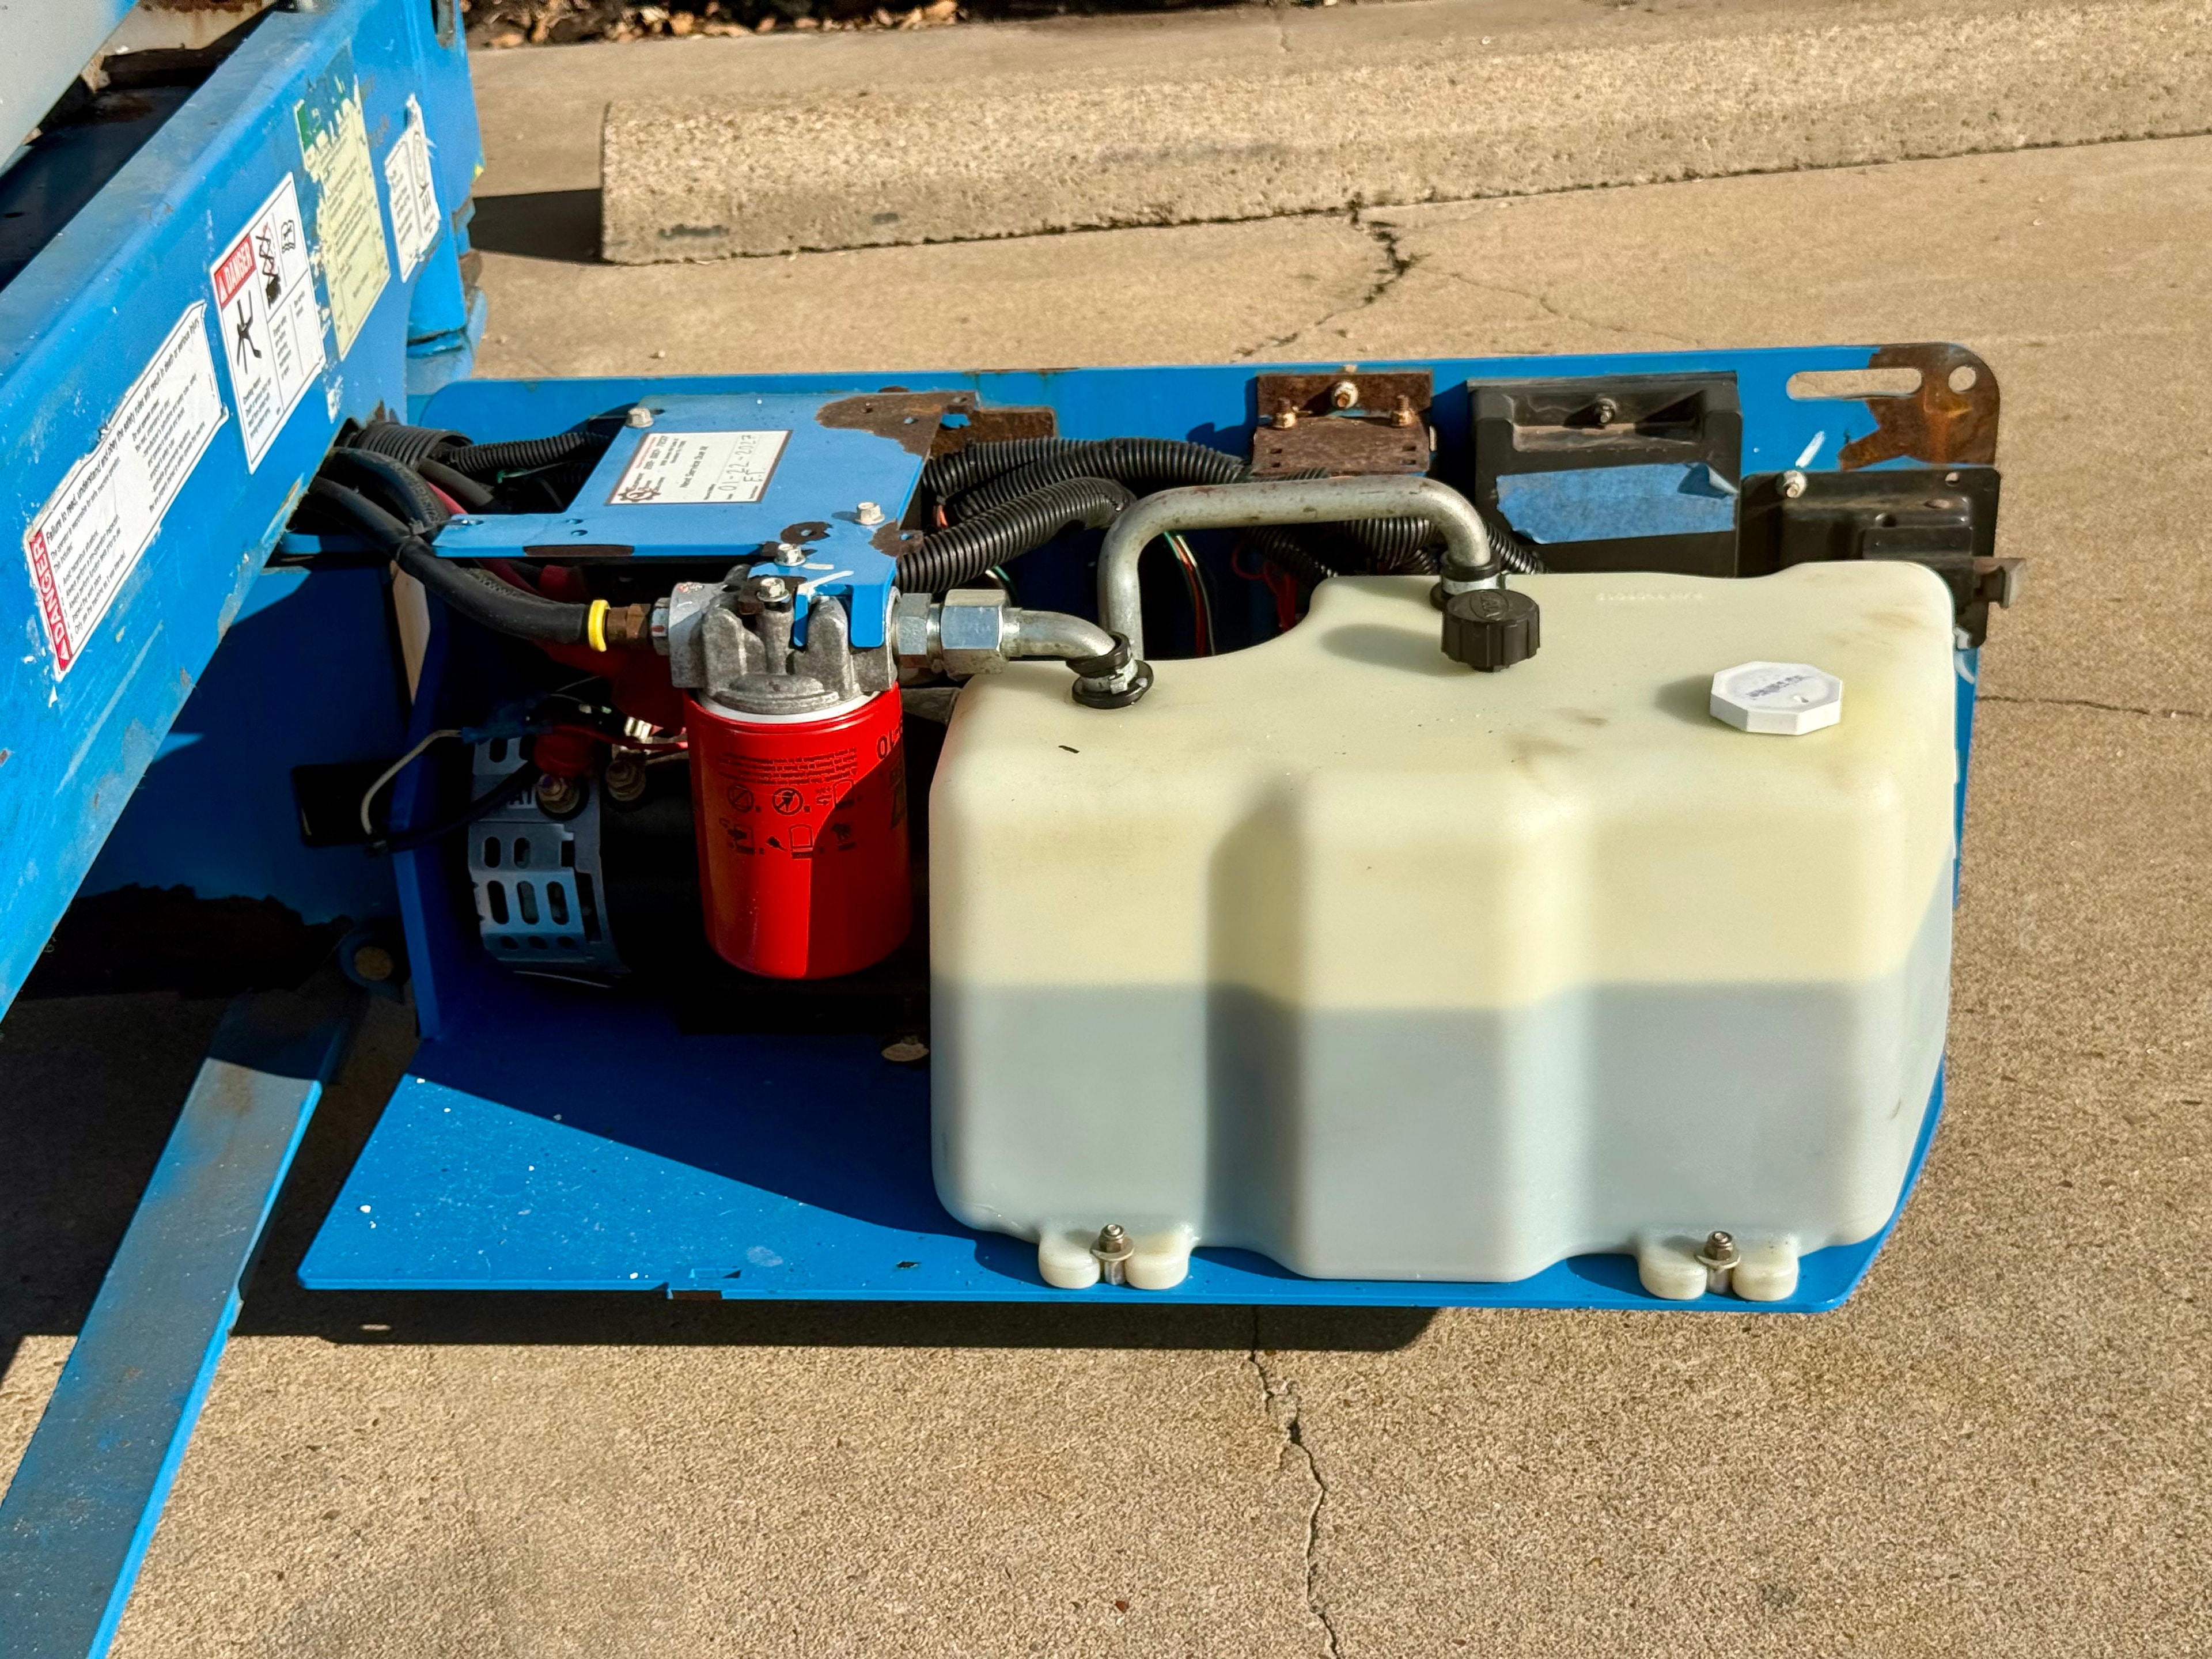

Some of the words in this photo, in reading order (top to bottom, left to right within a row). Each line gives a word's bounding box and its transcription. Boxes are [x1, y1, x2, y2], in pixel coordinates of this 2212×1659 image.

[225, 244, 254, 286] DANGER
[684, 461, 700, 476] Service
[694, 451, 705, 459] Due
[46, 518, 62, 544] Failure
[77, 461, 101, 500] understand
[108, 437, 117, 456] obey
[679, 478, 692, 487] Next
[33, 536, 65, 642] DANGER
